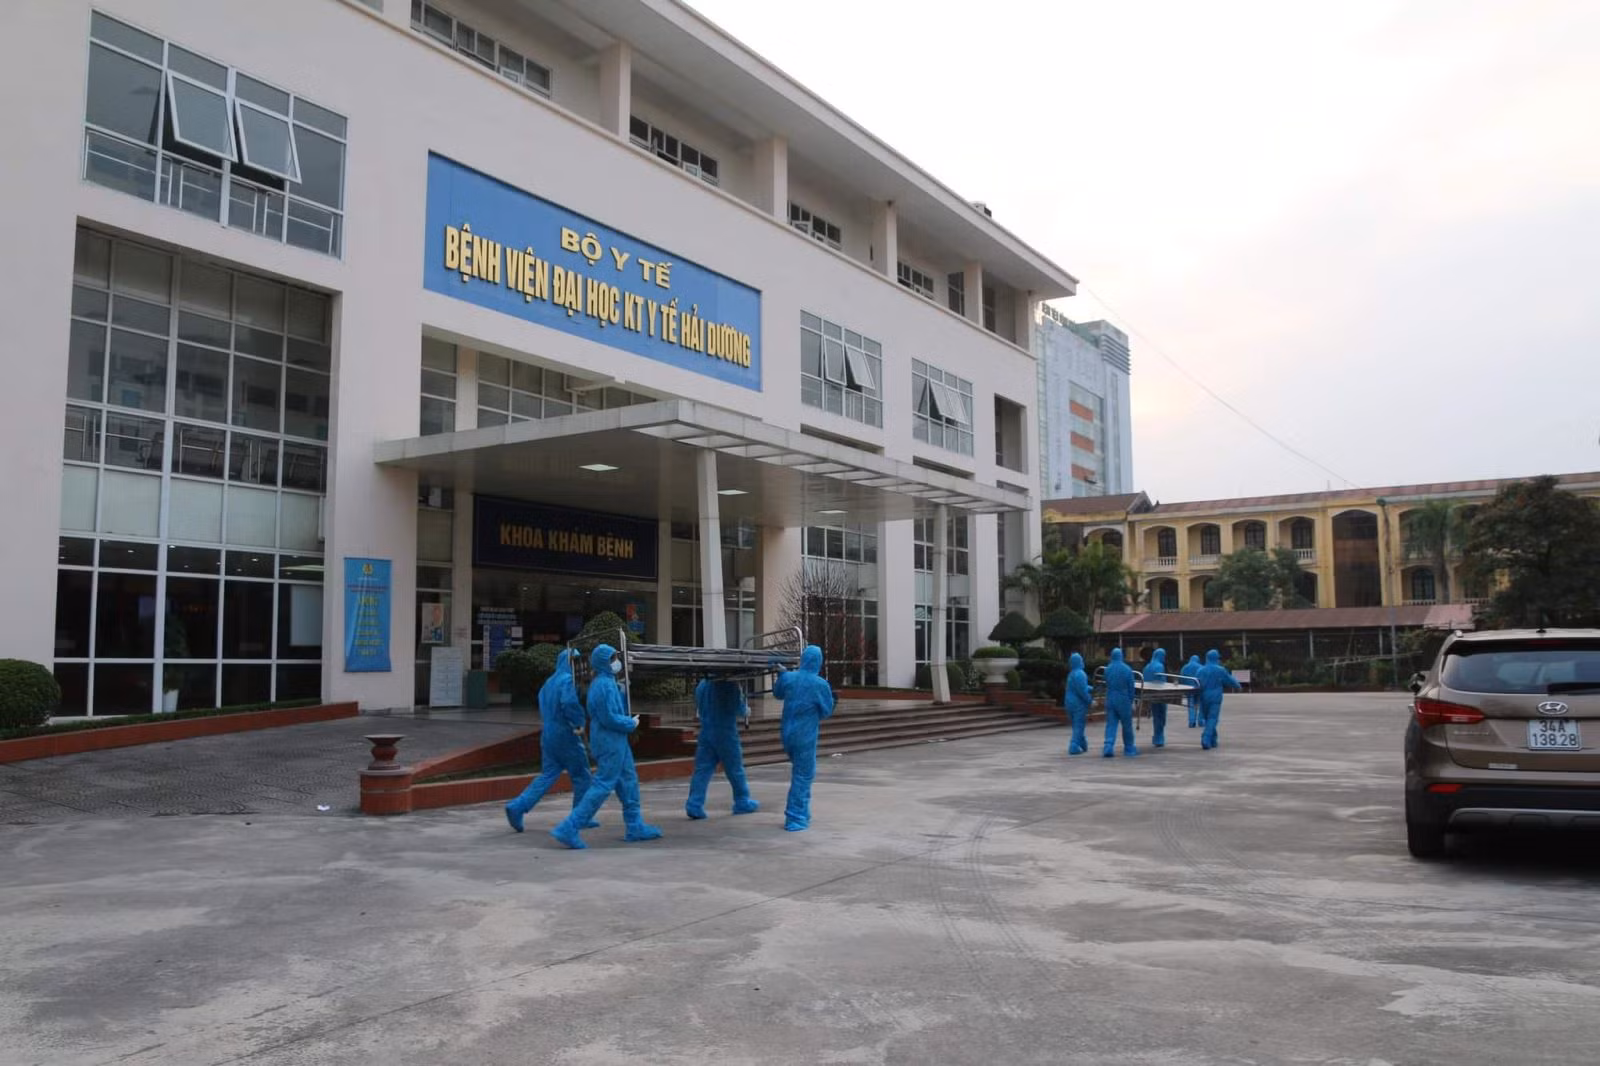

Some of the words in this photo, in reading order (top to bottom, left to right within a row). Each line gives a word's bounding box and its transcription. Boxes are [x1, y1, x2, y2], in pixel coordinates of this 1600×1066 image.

[561, 226, 603, 265] BỘ
[610, 247, 631, 272] Y
[638, 258, 672, 289] TẾ
[445, 223, 501, 284] BỆNH
[505, 246, 549, 303] VIỆN
[553, 264, 583, 317] ĐẠI
[586, 277, 620, 328] HỌC
[623, 291, 645, 333] KT
[647, 299, 657, 337] Y
[660, 297, 679, 344] TẾ
[681, 303, 705, 353] HẢI
[707, 320, 751, 369] DƯƠNG
[500, 522, 543, 549] KHOA
[548, 527, 594, 555] KHÁM
[597, 532, 634, 561] BỆNH
[1532, 733, 1577, 746] 138.28
[1539, 719, 1566, 733] 34A
